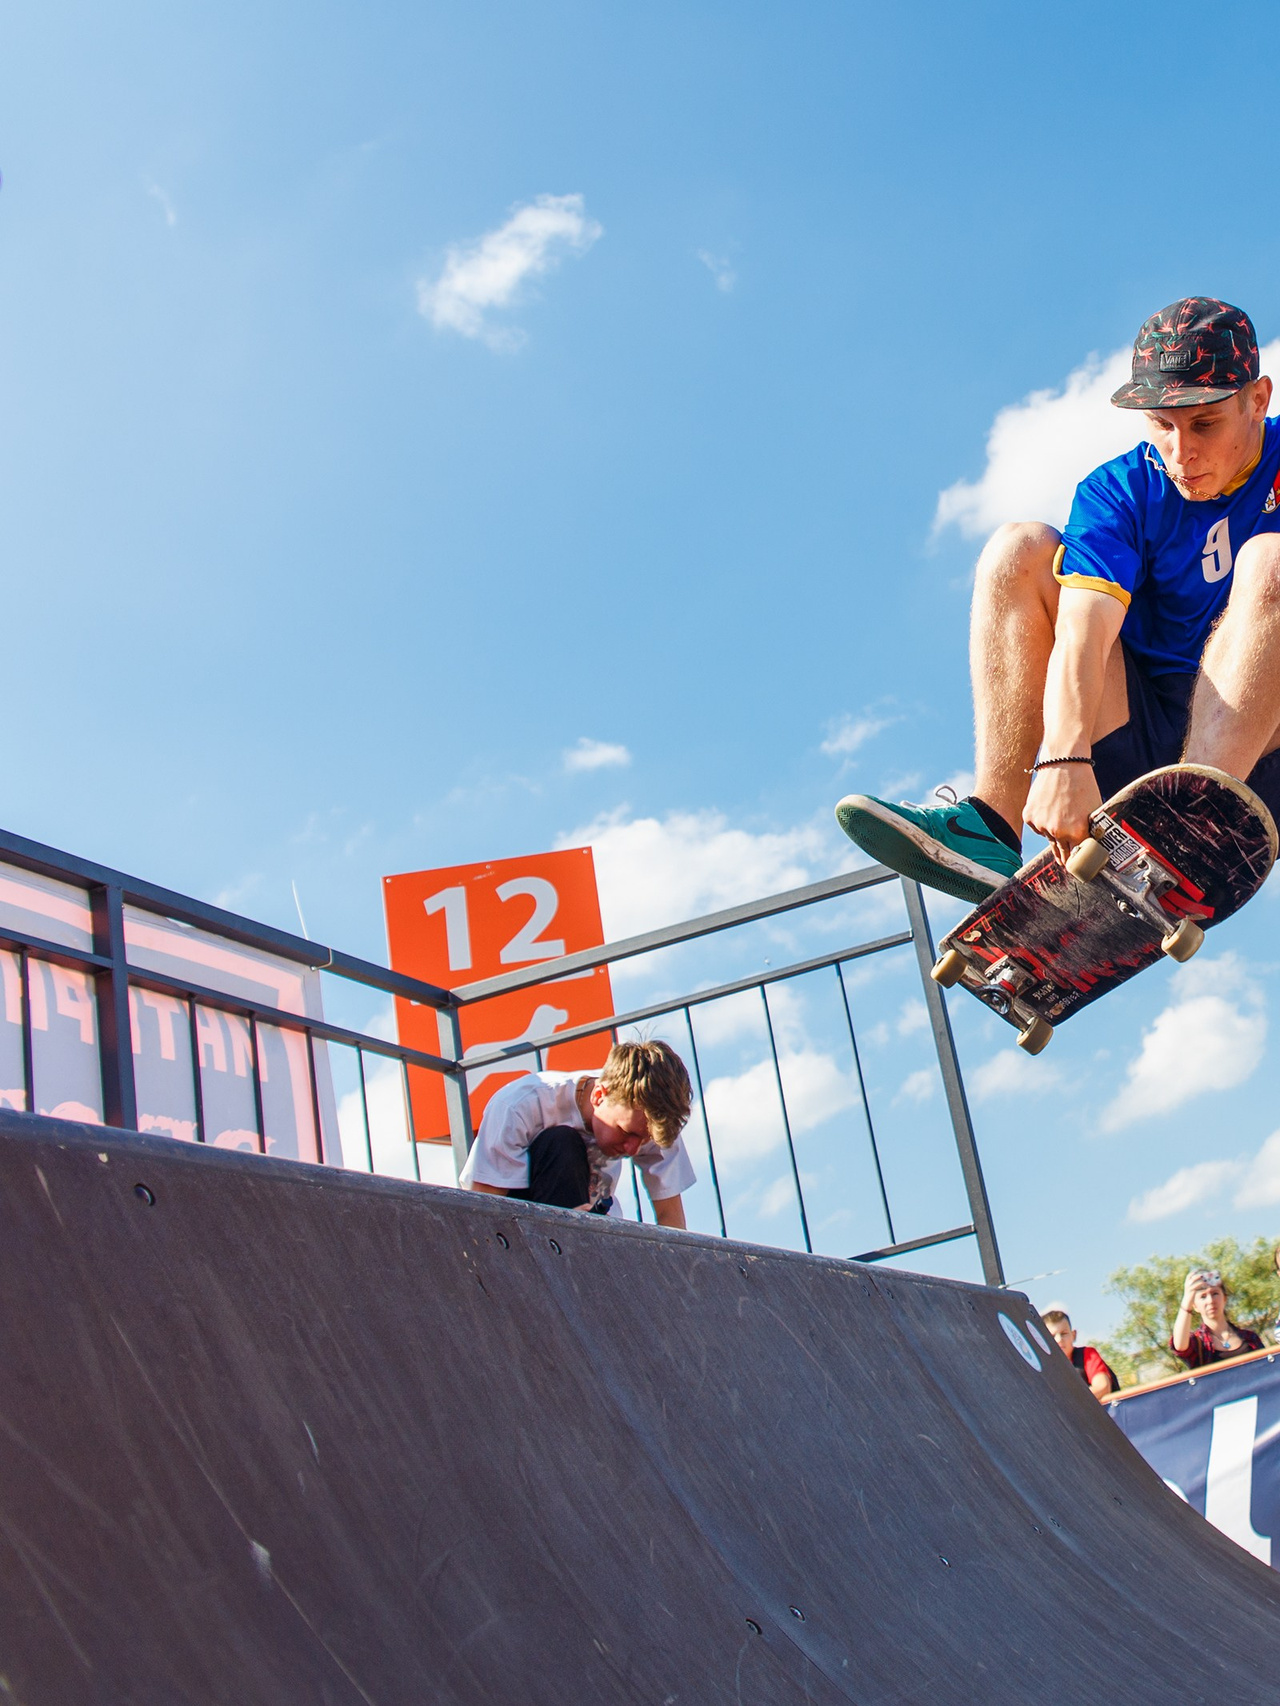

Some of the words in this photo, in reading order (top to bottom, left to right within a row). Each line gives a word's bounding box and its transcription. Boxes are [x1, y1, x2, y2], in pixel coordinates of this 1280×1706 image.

[1165, 354, 1187, 365] VANS
[1201, 517, 1234, 584] 9
[423, 876, 566, 972] 12
